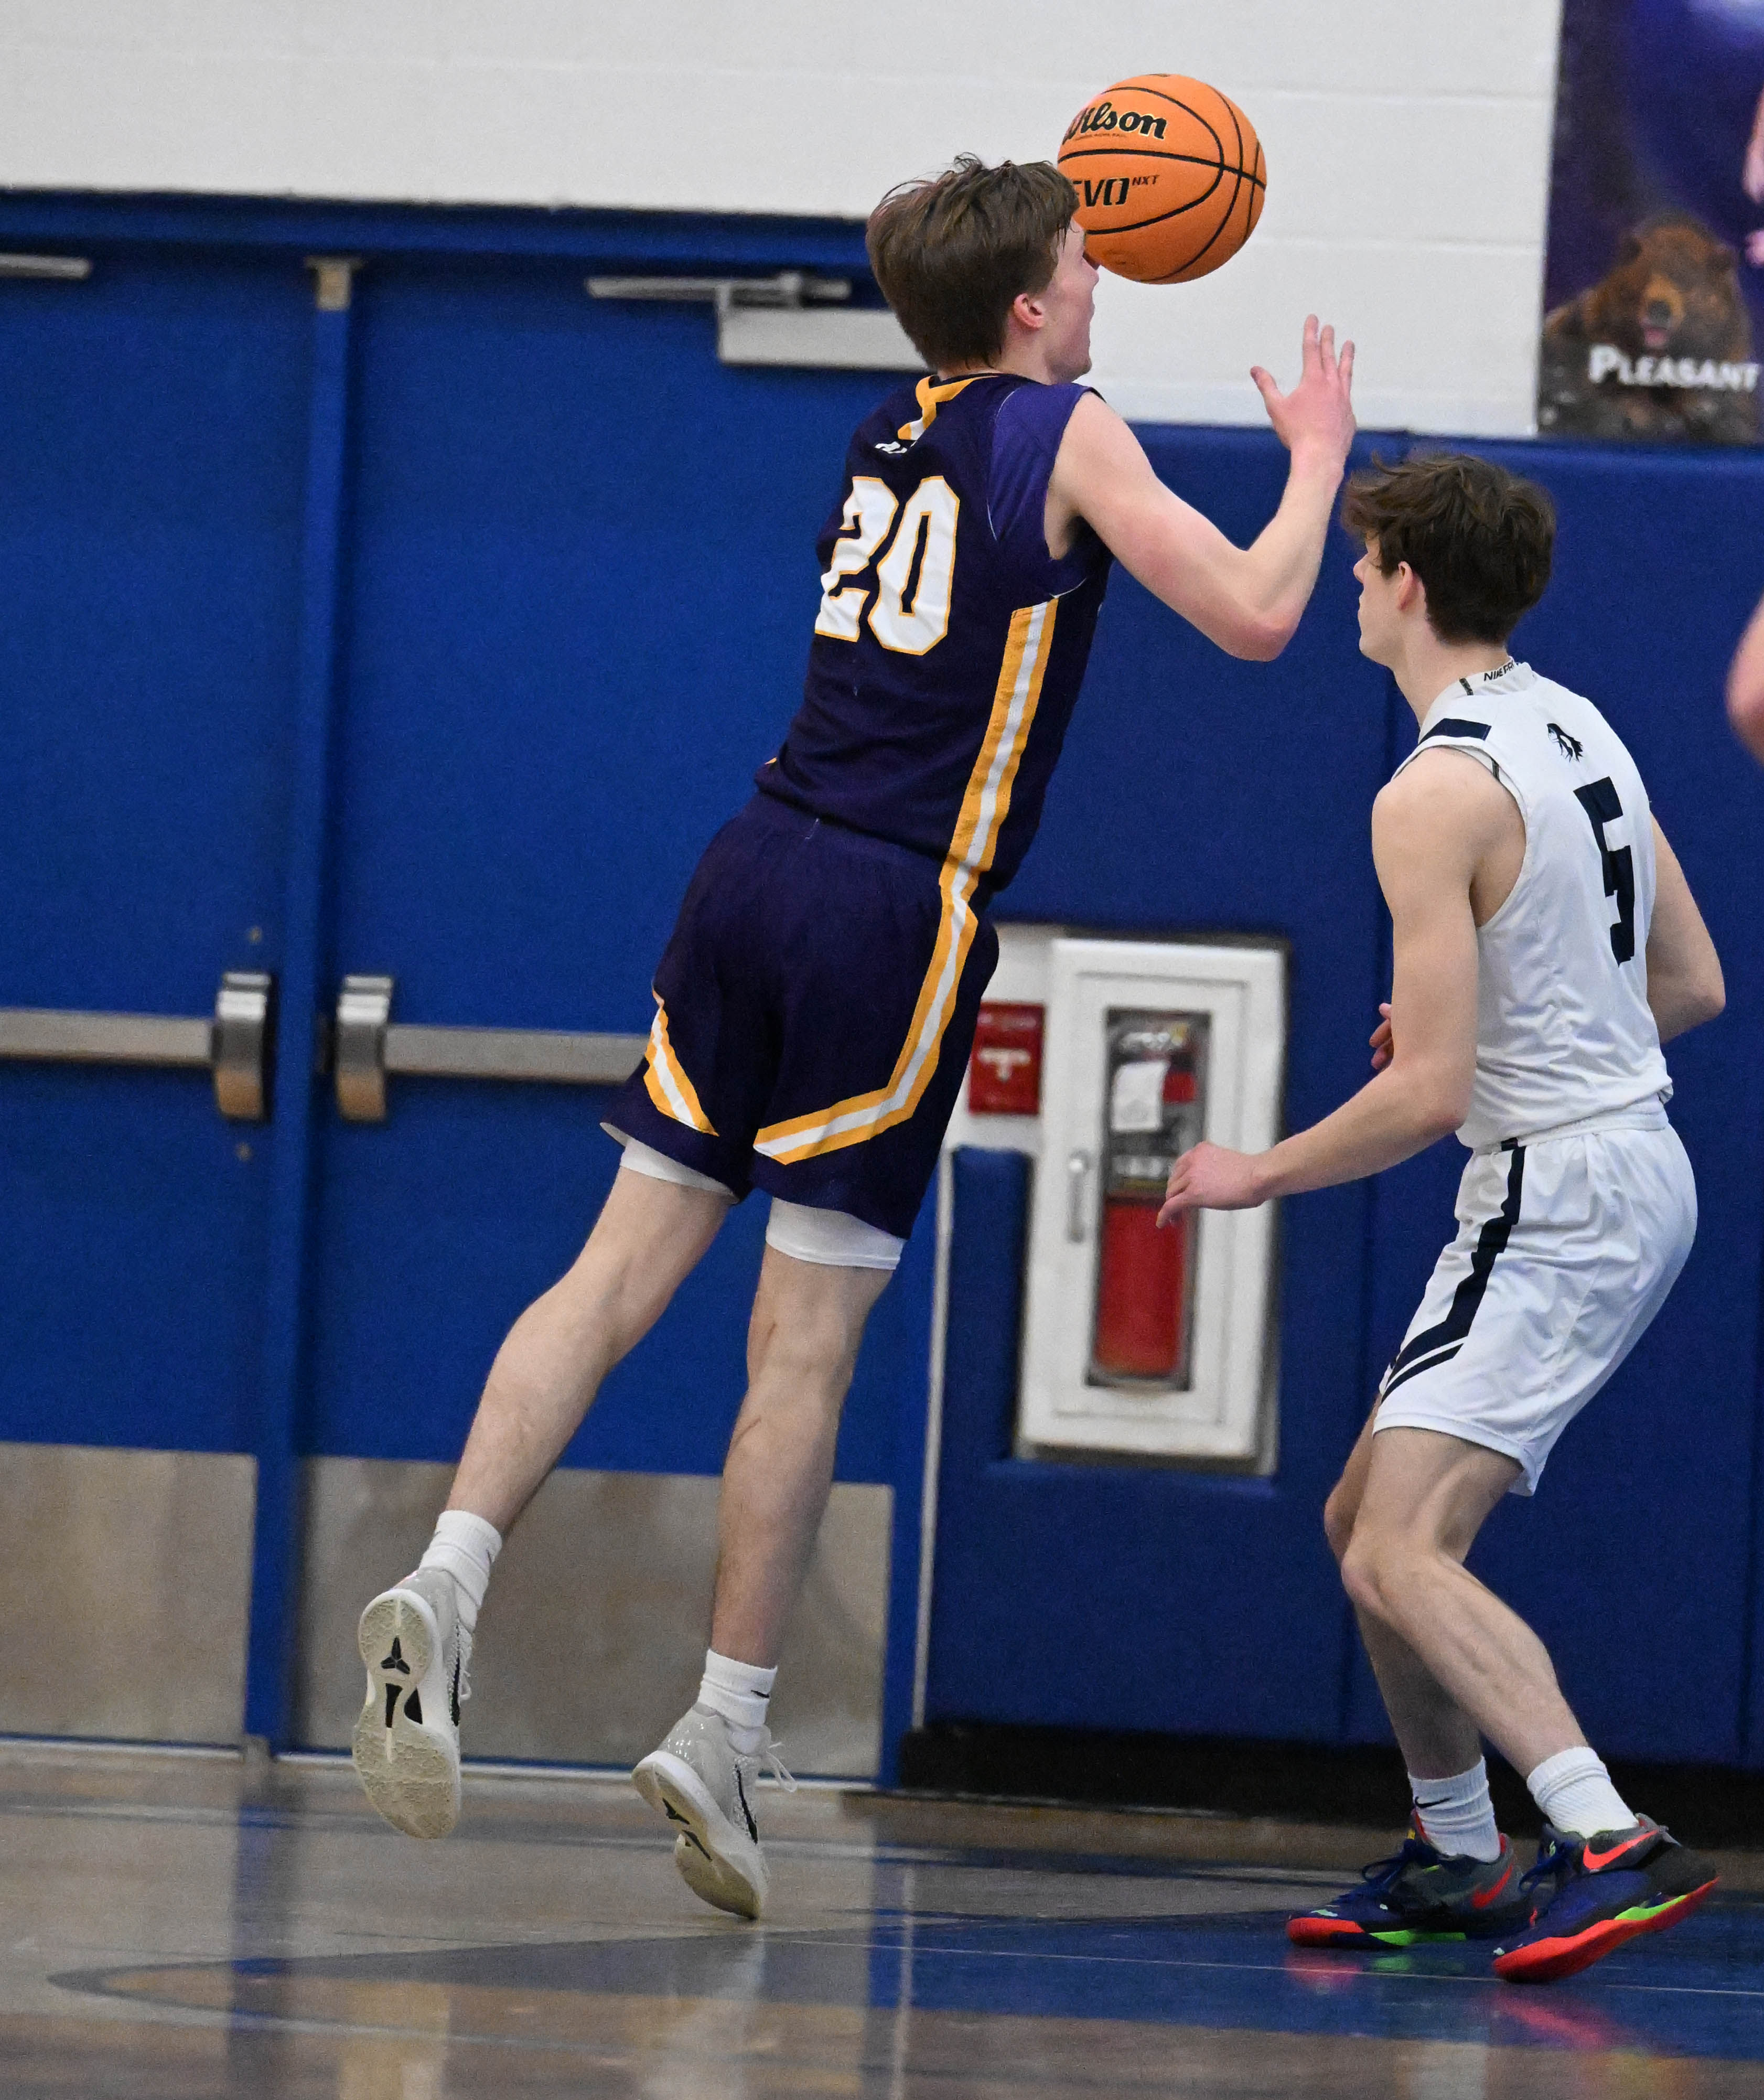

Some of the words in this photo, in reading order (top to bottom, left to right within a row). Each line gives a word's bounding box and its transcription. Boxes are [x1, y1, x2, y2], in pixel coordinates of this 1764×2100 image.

[1132, 174, 1160, 186] NXT
[814, 475, 960, 656] 20
[1573, 776, 1635, 967] 5
